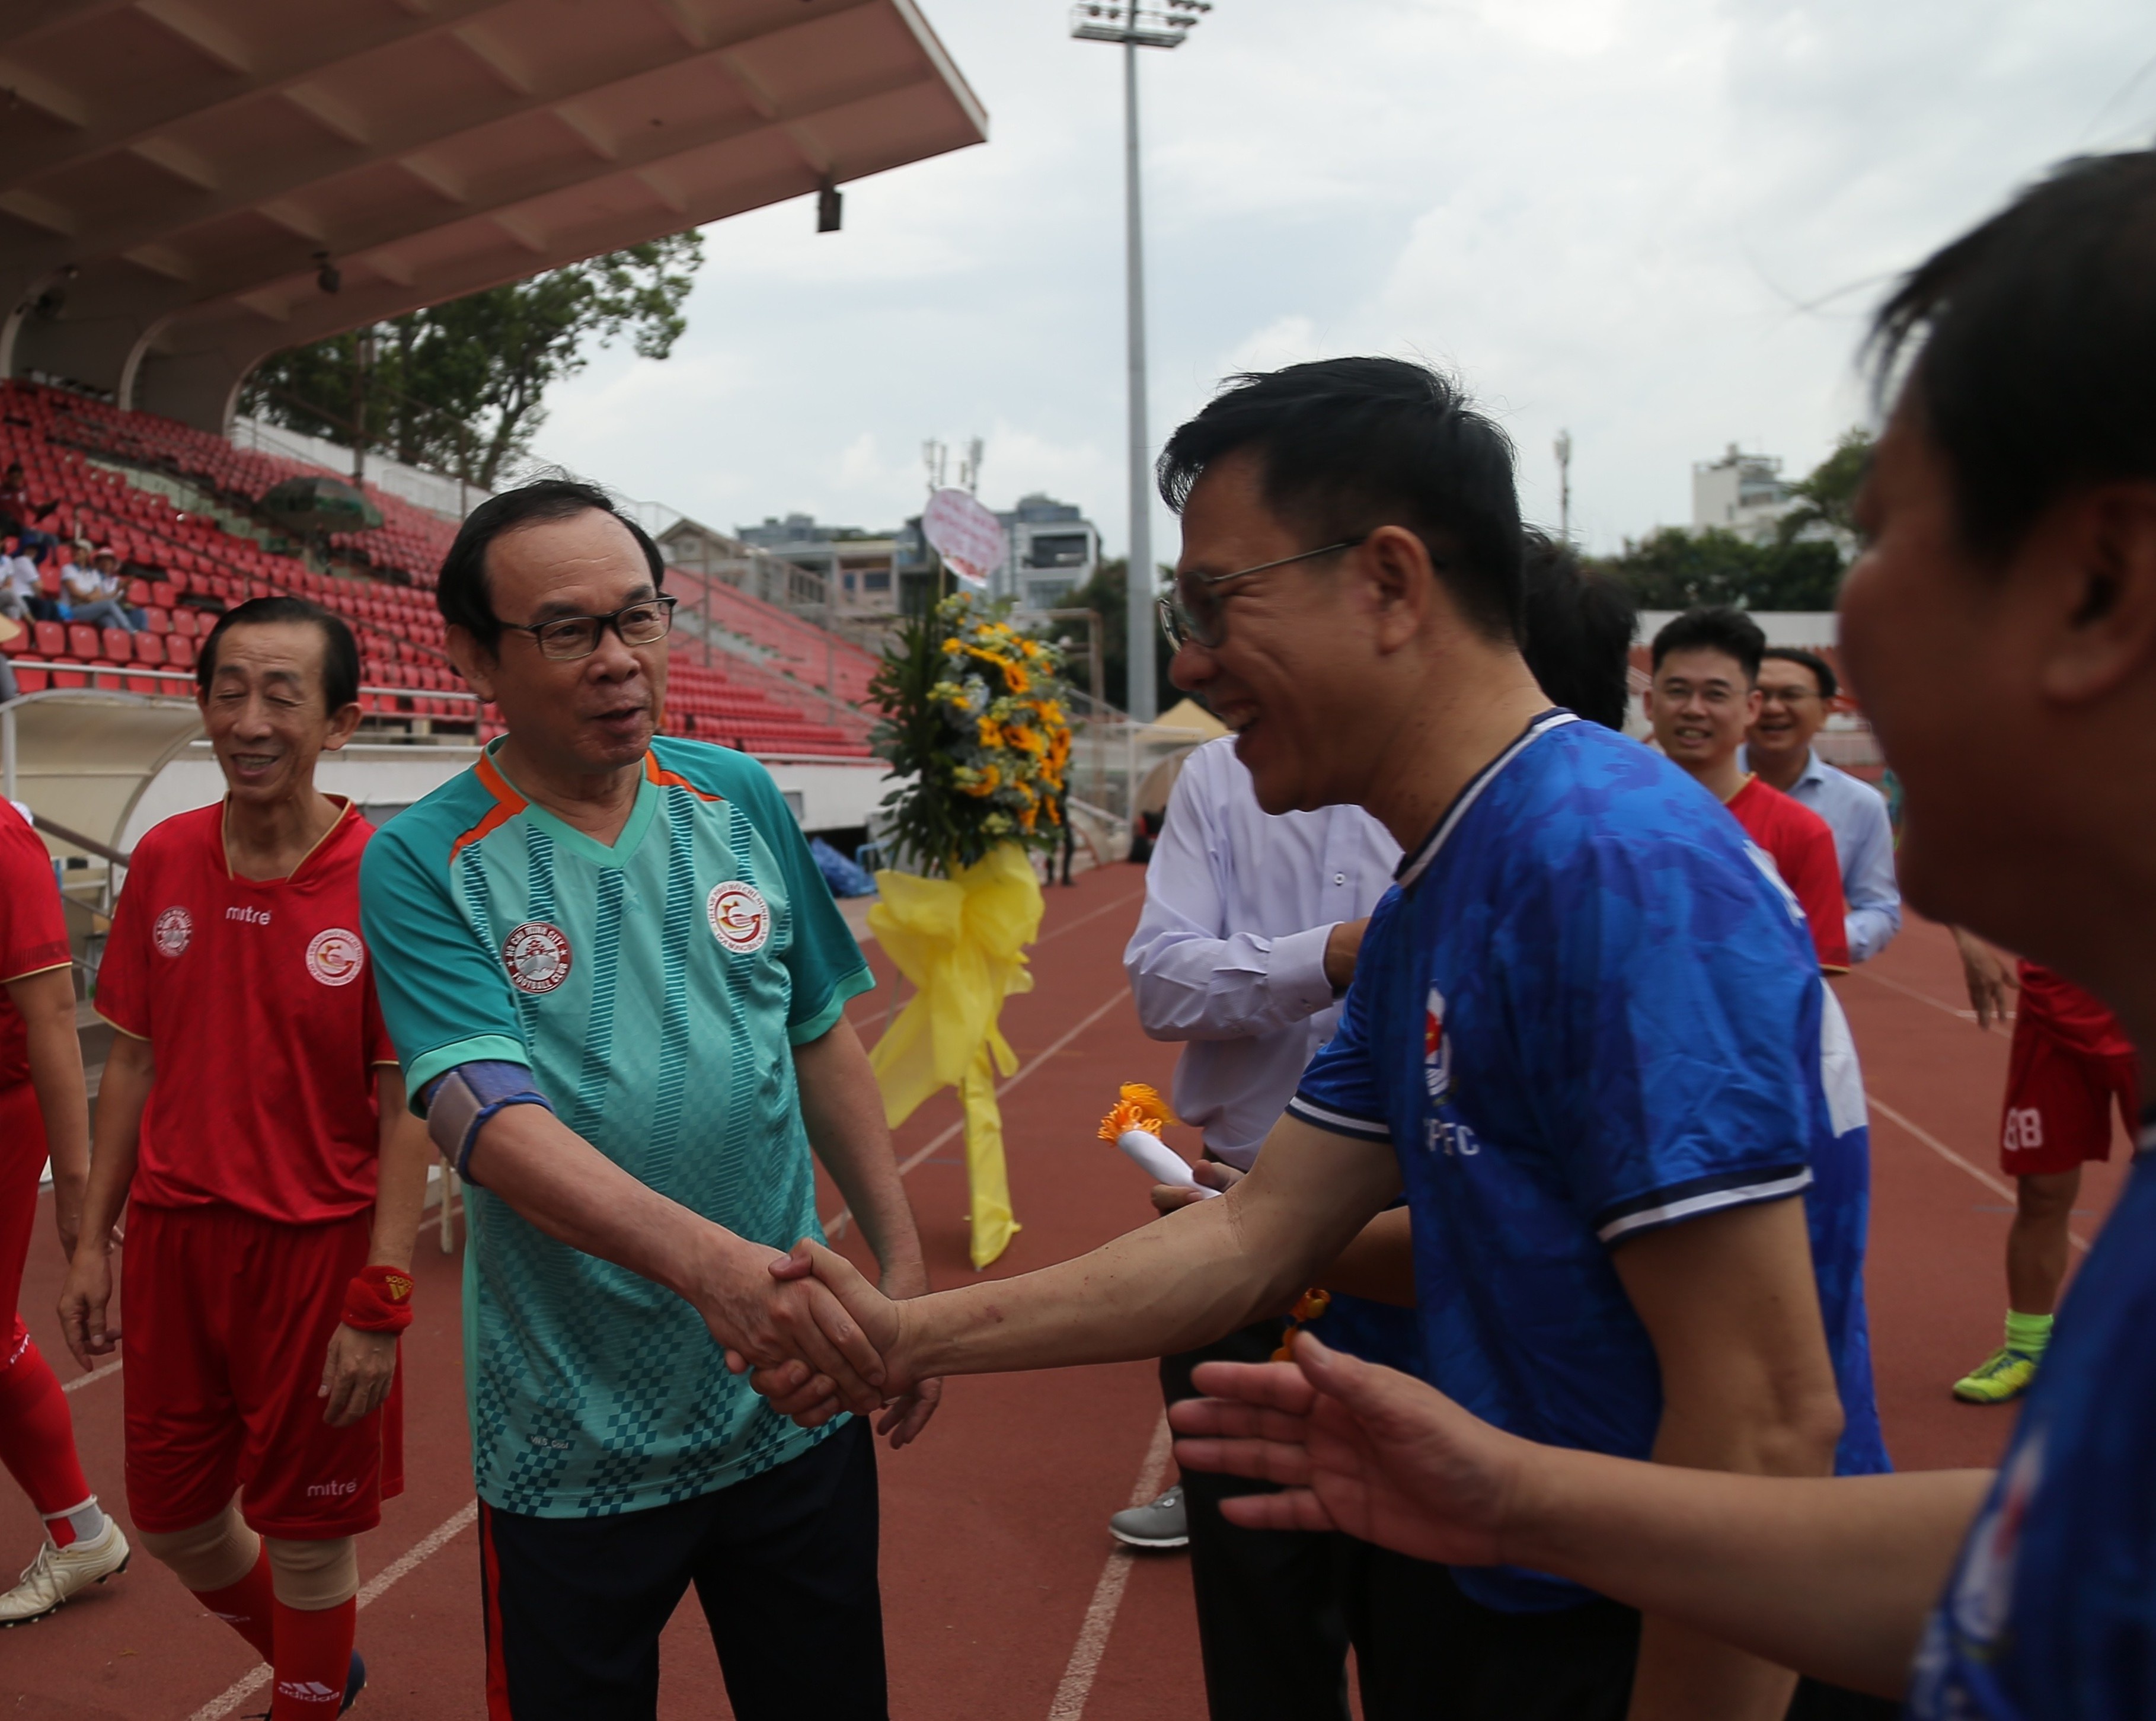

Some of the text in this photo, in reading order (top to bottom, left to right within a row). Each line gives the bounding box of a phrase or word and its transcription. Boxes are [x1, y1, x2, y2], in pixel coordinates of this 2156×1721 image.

[225, 905, 271, 925] mitre
[547, 931, 566, 946] CITY
[512, 972, 552, 989] FOOTBALL
[1423, 1119, 1480, 1155] PFC
[2004, 1107, 2043, 1151] 88
[307, 1480, 356, 1496] mitre
[279, 1687, 340, 1701] adidas
